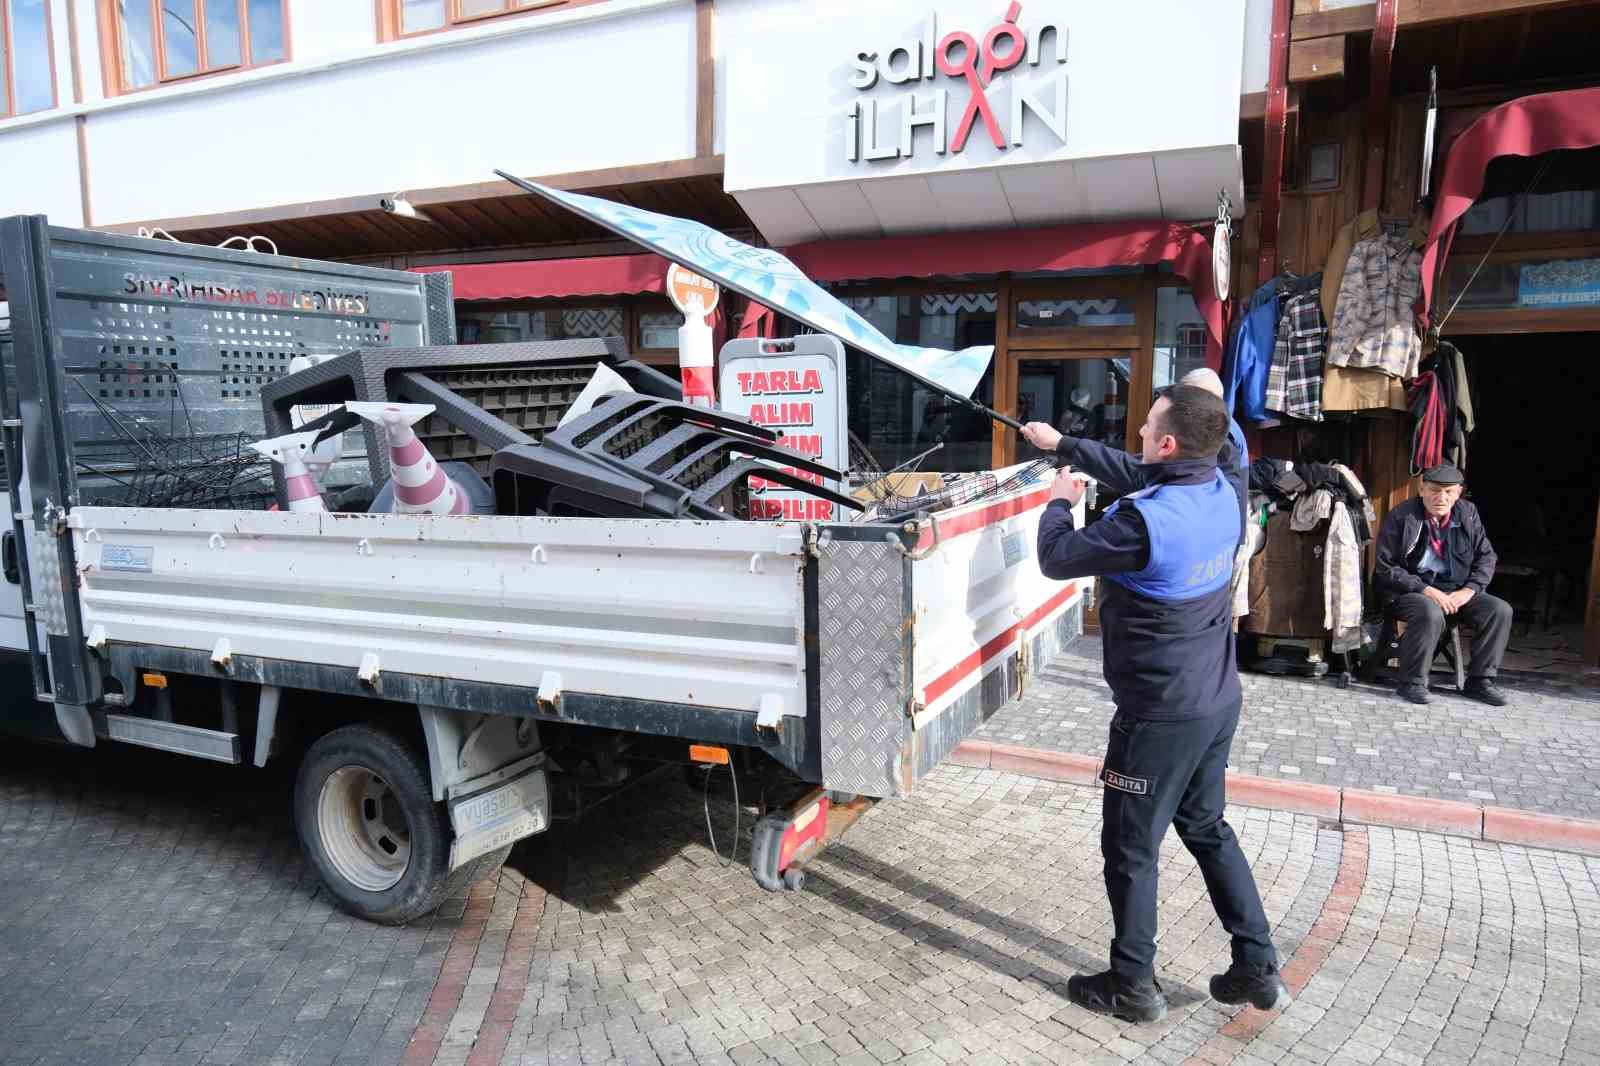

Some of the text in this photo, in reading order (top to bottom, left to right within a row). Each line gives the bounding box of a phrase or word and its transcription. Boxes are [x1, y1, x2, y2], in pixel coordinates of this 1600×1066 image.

[737, 368, 823, 396] TARLA
[749, 402, 813, 427] ALIM
[1107, 773, 1141, 791] ZABITA
